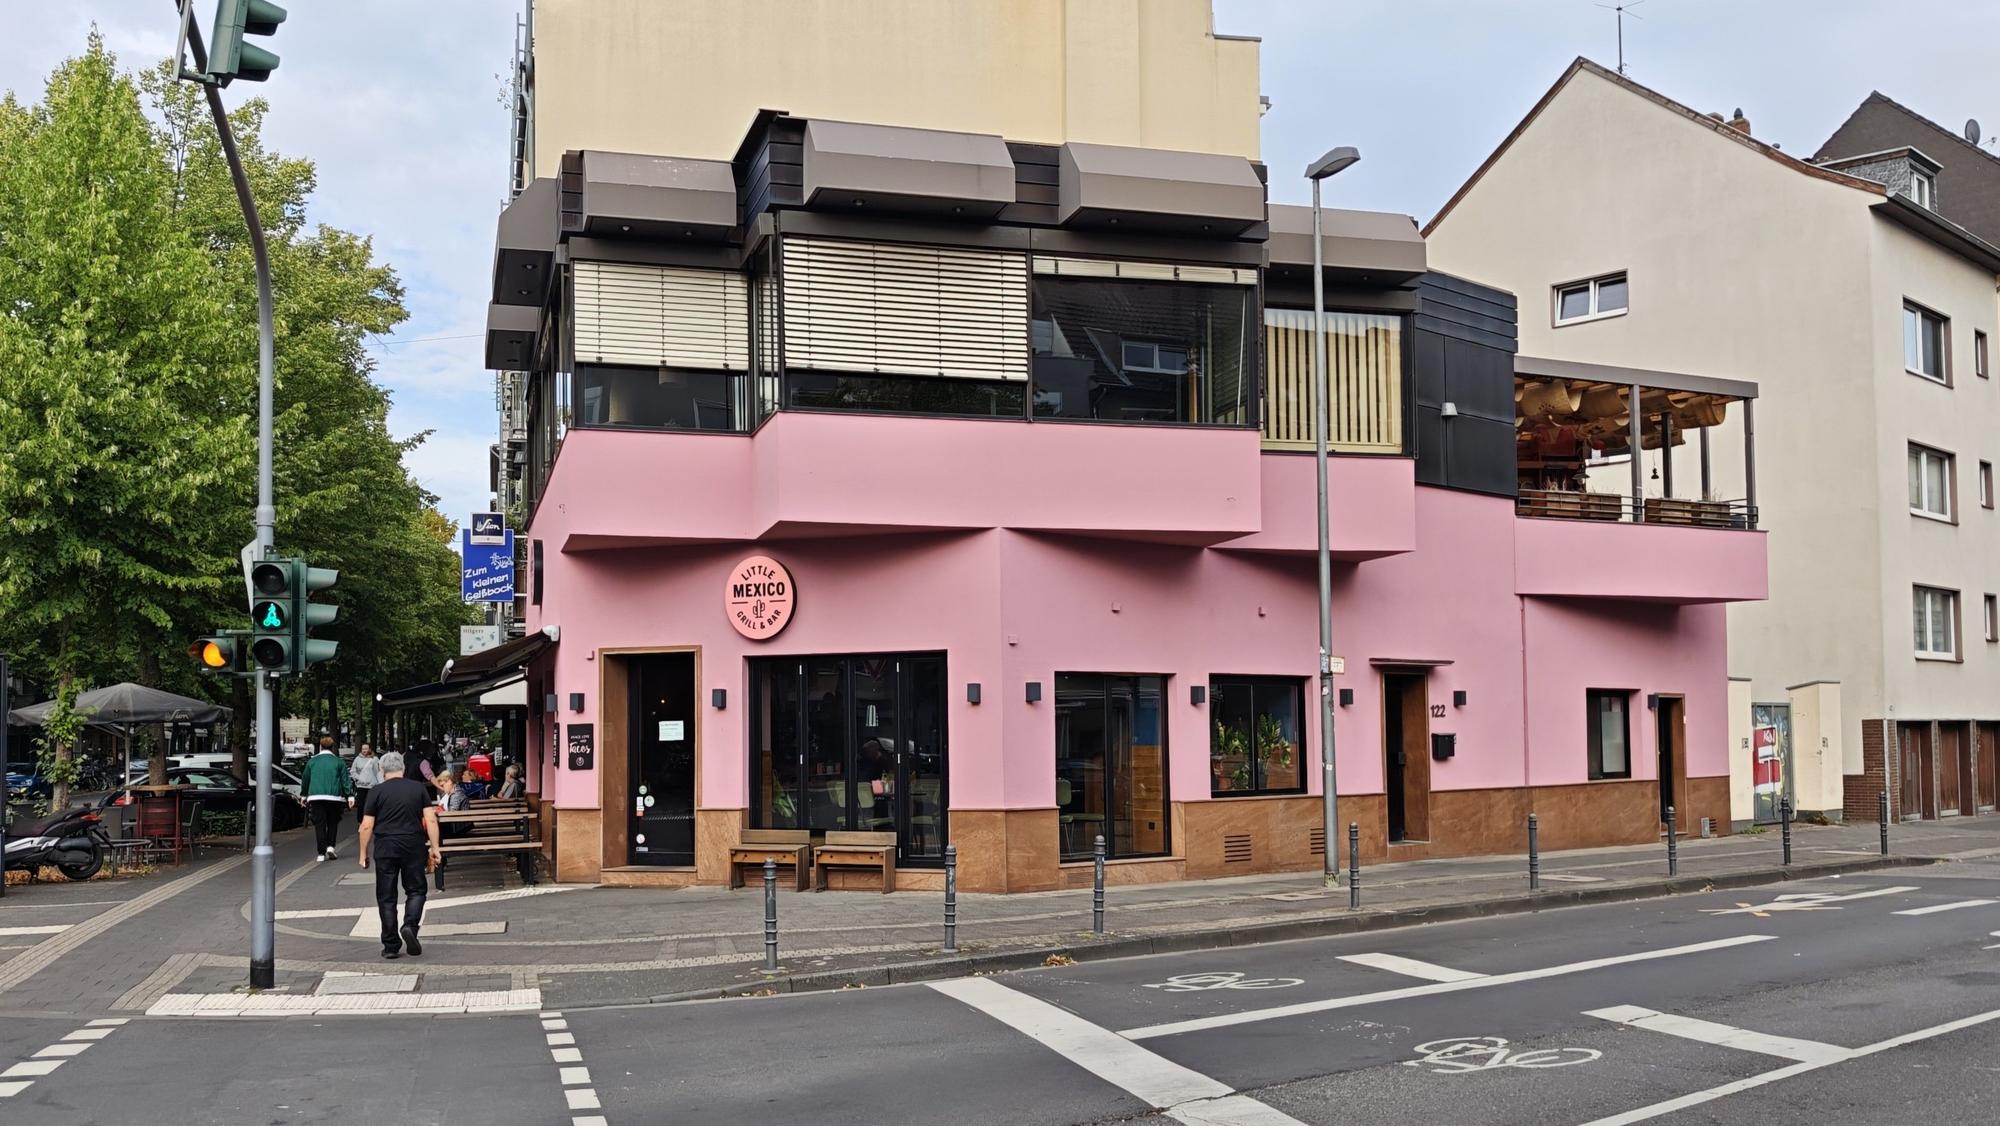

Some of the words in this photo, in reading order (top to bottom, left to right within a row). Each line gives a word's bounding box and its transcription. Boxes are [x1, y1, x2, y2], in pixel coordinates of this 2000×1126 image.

[475, 518, 500, 532] Sion
[464, 566, 487, 578] Zum
[741, 565, 776, 581] LITTLE
[465, 583, 513, 601] Geißbock
[733, 582, 785, 598] MEXICO
[736, 610, 757, 630] GRILL
[760, 621, 766, 630] &
[767, 609, 782, 626] BAR
[1430, 704, 1446, 718] 122
[569, 741, 591, 754] Tacos
